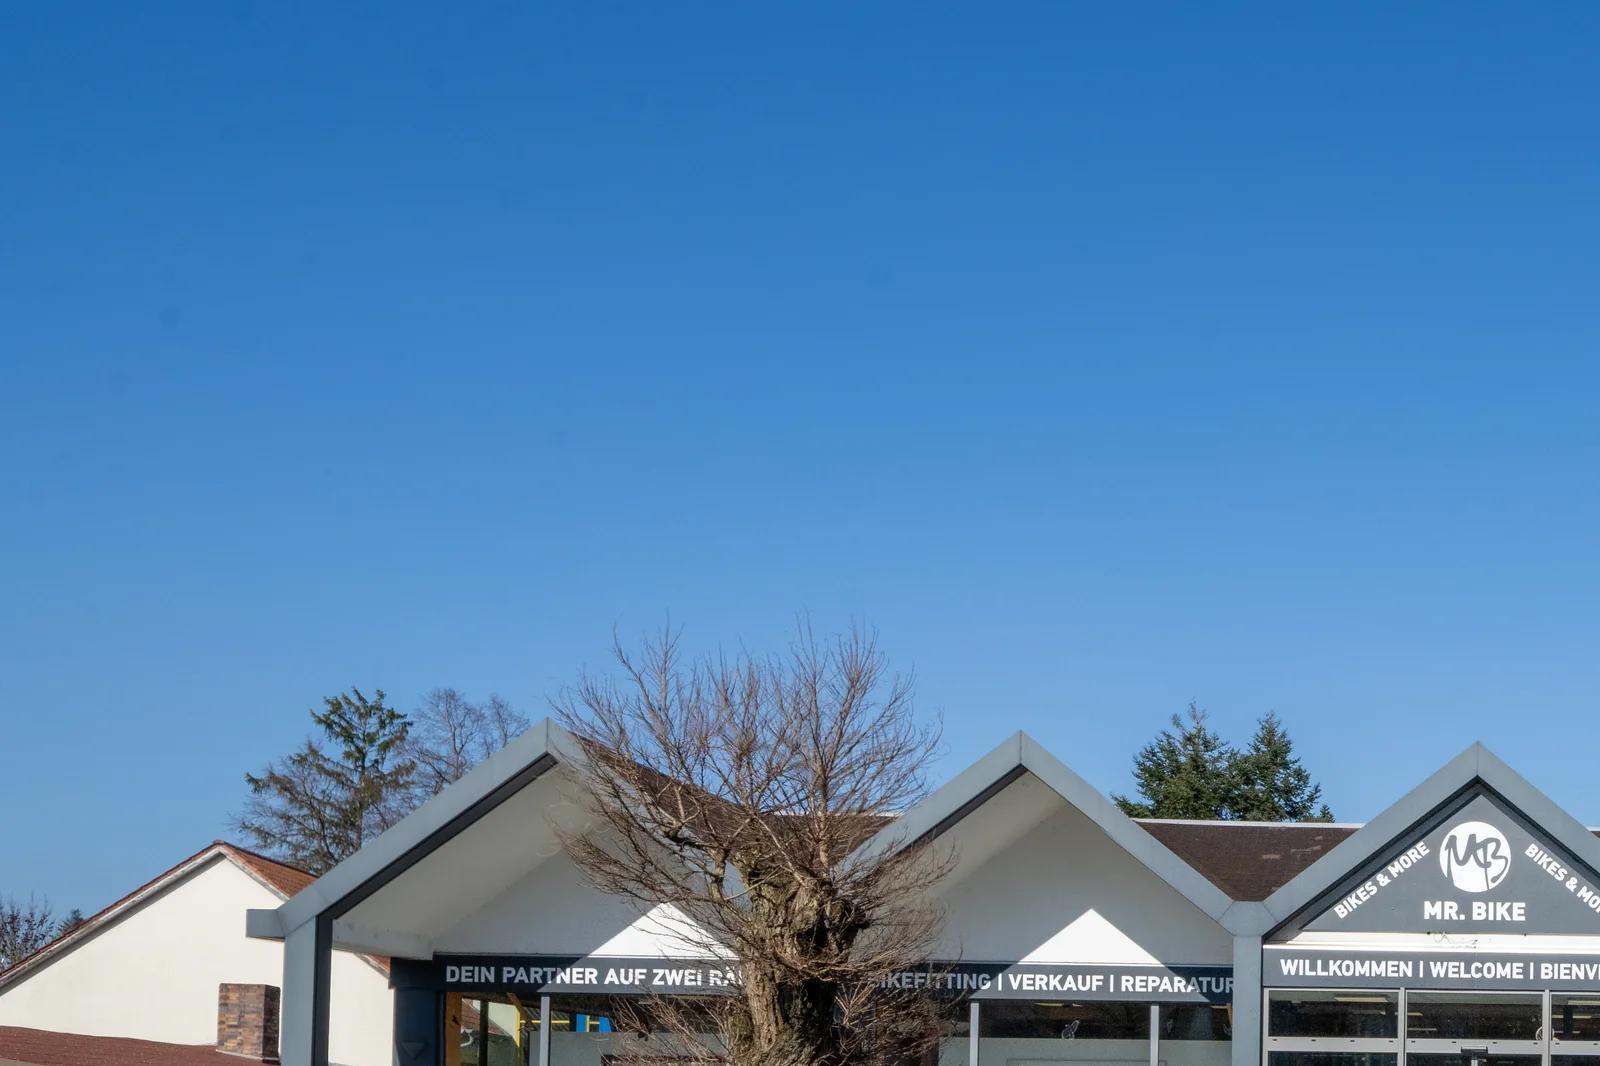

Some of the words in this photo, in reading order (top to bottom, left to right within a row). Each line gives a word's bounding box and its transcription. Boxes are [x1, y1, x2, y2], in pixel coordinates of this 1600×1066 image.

[1524, 842, 1569, 884] BIKES
[1565, 877, 1578, 892] &
[1333, 885, 1378, 919] BIKES
[1378, 873, 1392, 888] &
[1389, 840, 1431, 880] MORE
[1423, 901, 1467, 921] MR.
[1472, 901, 1527, 922] BIKE
[445, 965, 495, 984] DEIN
[502, 966, 598, 985] PARTNER
[603, 966, 647, 986] AUF
[652, 968, 702, 986] ZWEI
[1280, 958, 1413, 978] WILLKOMMEN
[1429, 960, 1524, 979] WELCOME
[1009, 973, 1104, 992] VERKAUF
[1120, 975, 1234, 993] REPARATUR
